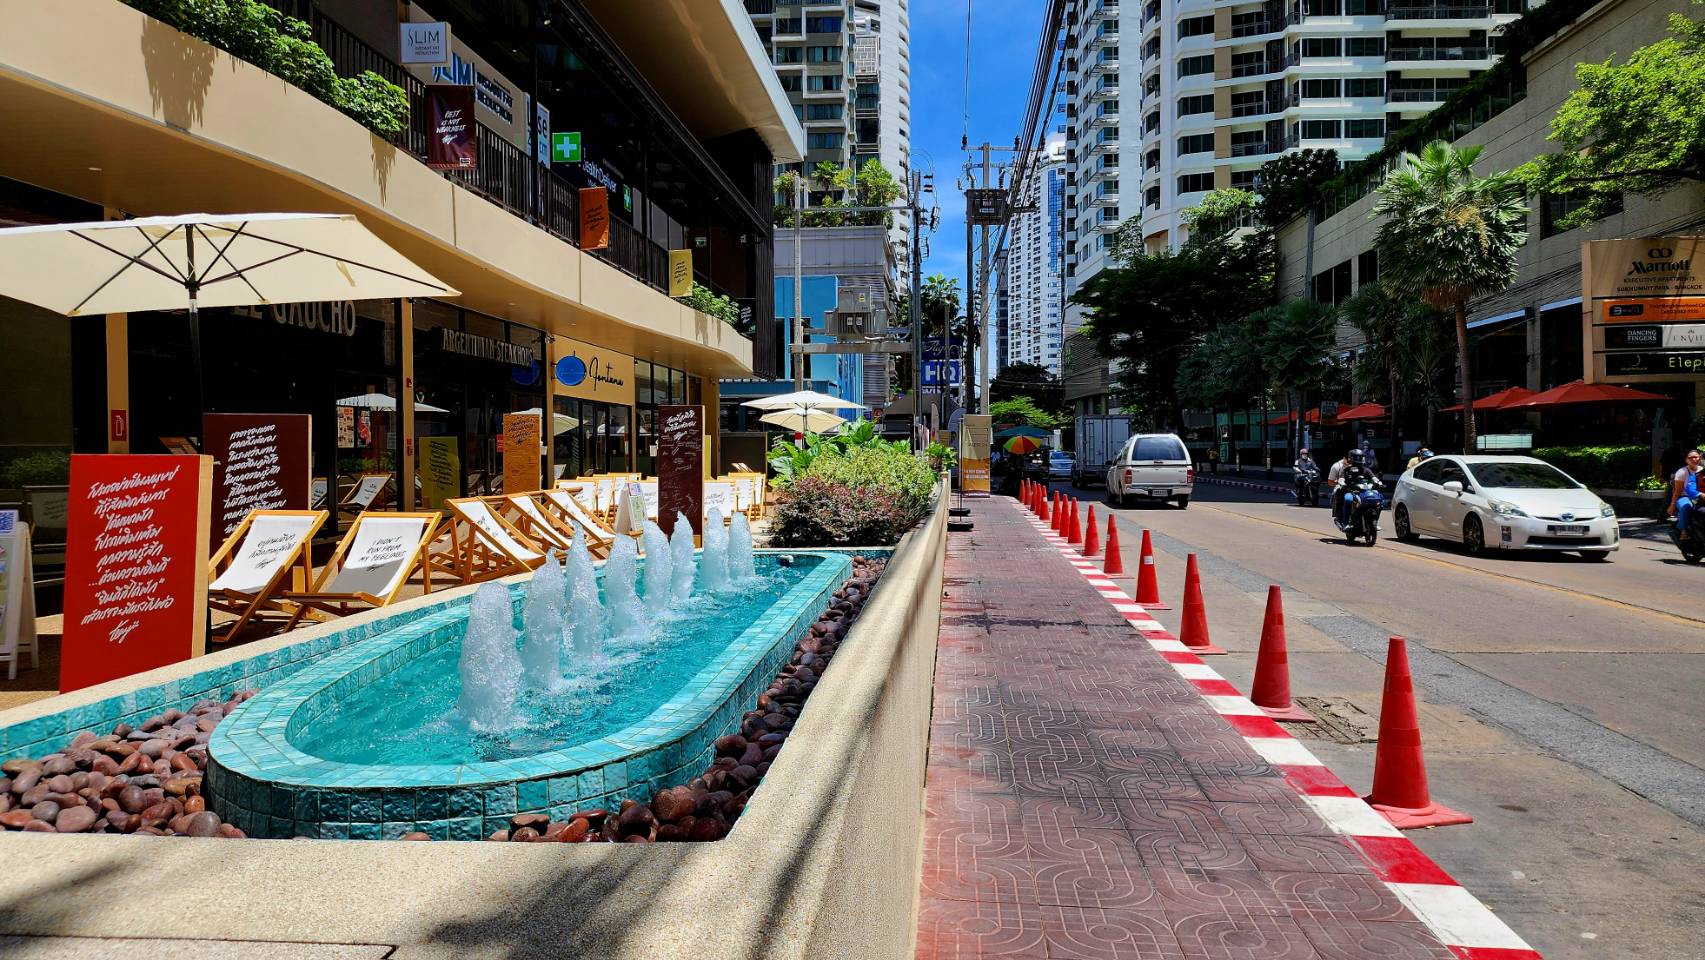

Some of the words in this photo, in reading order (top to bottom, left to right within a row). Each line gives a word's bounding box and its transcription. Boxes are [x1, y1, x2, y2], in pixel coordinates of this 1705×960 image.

[407, 28, 439, 47] SLIM
[448, 118, 462, 126] NOT
[1628, 259, 1690, 275] Marriott
